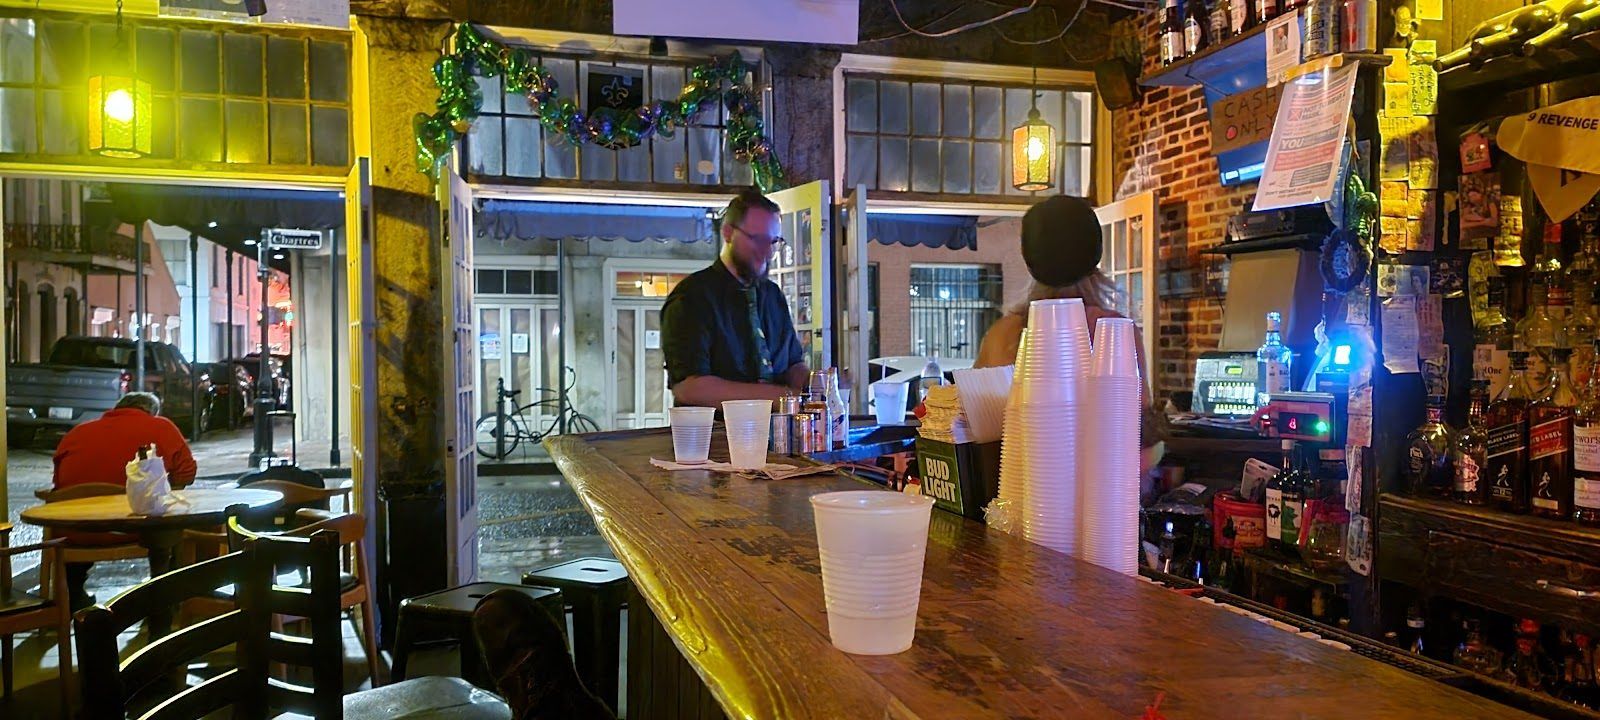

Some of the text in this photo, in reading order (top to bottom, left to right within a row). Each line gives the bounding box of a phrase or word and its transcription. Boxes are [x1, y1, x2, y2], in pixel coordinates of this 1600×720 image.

[1224, 86, 1276, 118] CASH
[1225, 111, 1277, 141] ONLY
[1537, 113, 1599, 130] REVENGE
[1281, 138, 1304, 149] YOU
[272, 234, 319, 246] Chartres
[1503, 432, 1520, 441] LABEL
[1540, 430, 1562, 441] LABEL
[925, 457, 950, 481] BUD
[923, 475, 956, 503] LIGHT
